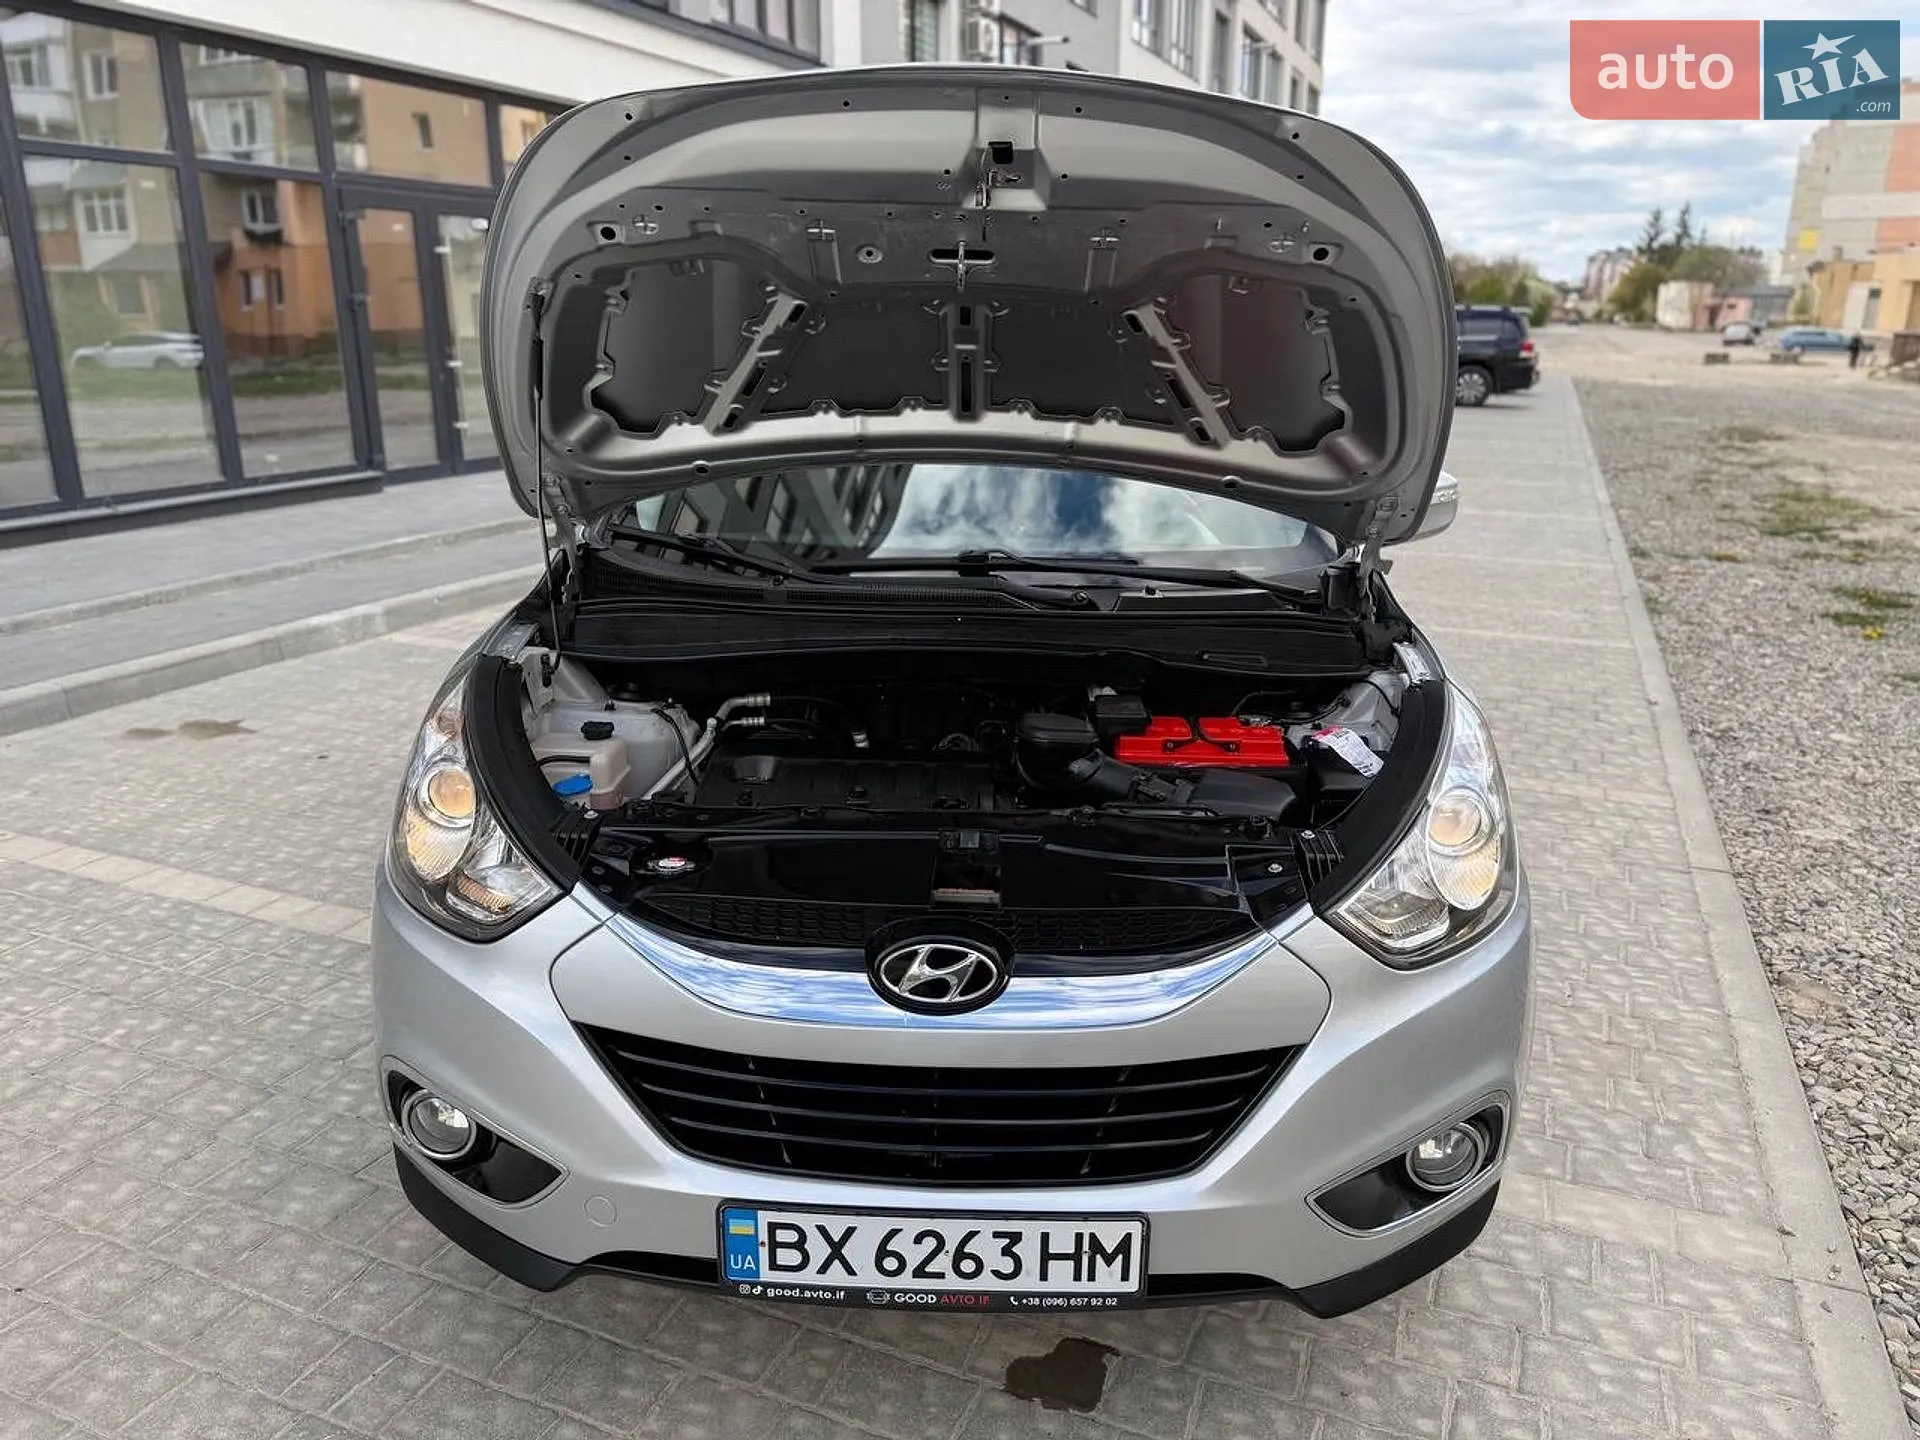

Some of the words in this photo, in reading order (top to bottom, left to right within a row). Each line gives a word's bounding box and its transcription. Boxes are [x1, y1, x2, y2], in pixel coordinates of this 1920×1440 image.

[766, 1221, 859, 1277] BX
[874, 1227, 1023, 1280] 6263
[1039, 1230, 1133, 1283] HM
[729, 1253, 757, 1271] UA
[766, 1287, 846, 1300] good.avto.if
[894, 1292, 937, 1304] GOOD
[941, 1294, 975, 1305] AVTO
[1021, 1297, 1040, 1306] +38
[1042, 1296, 1068, 1307] (096)
[1069, 1297, 1088, 1306] 657
[1090, 1297, 1103, 1306] 92
[1105, 1297, 1118, 1306] 02
